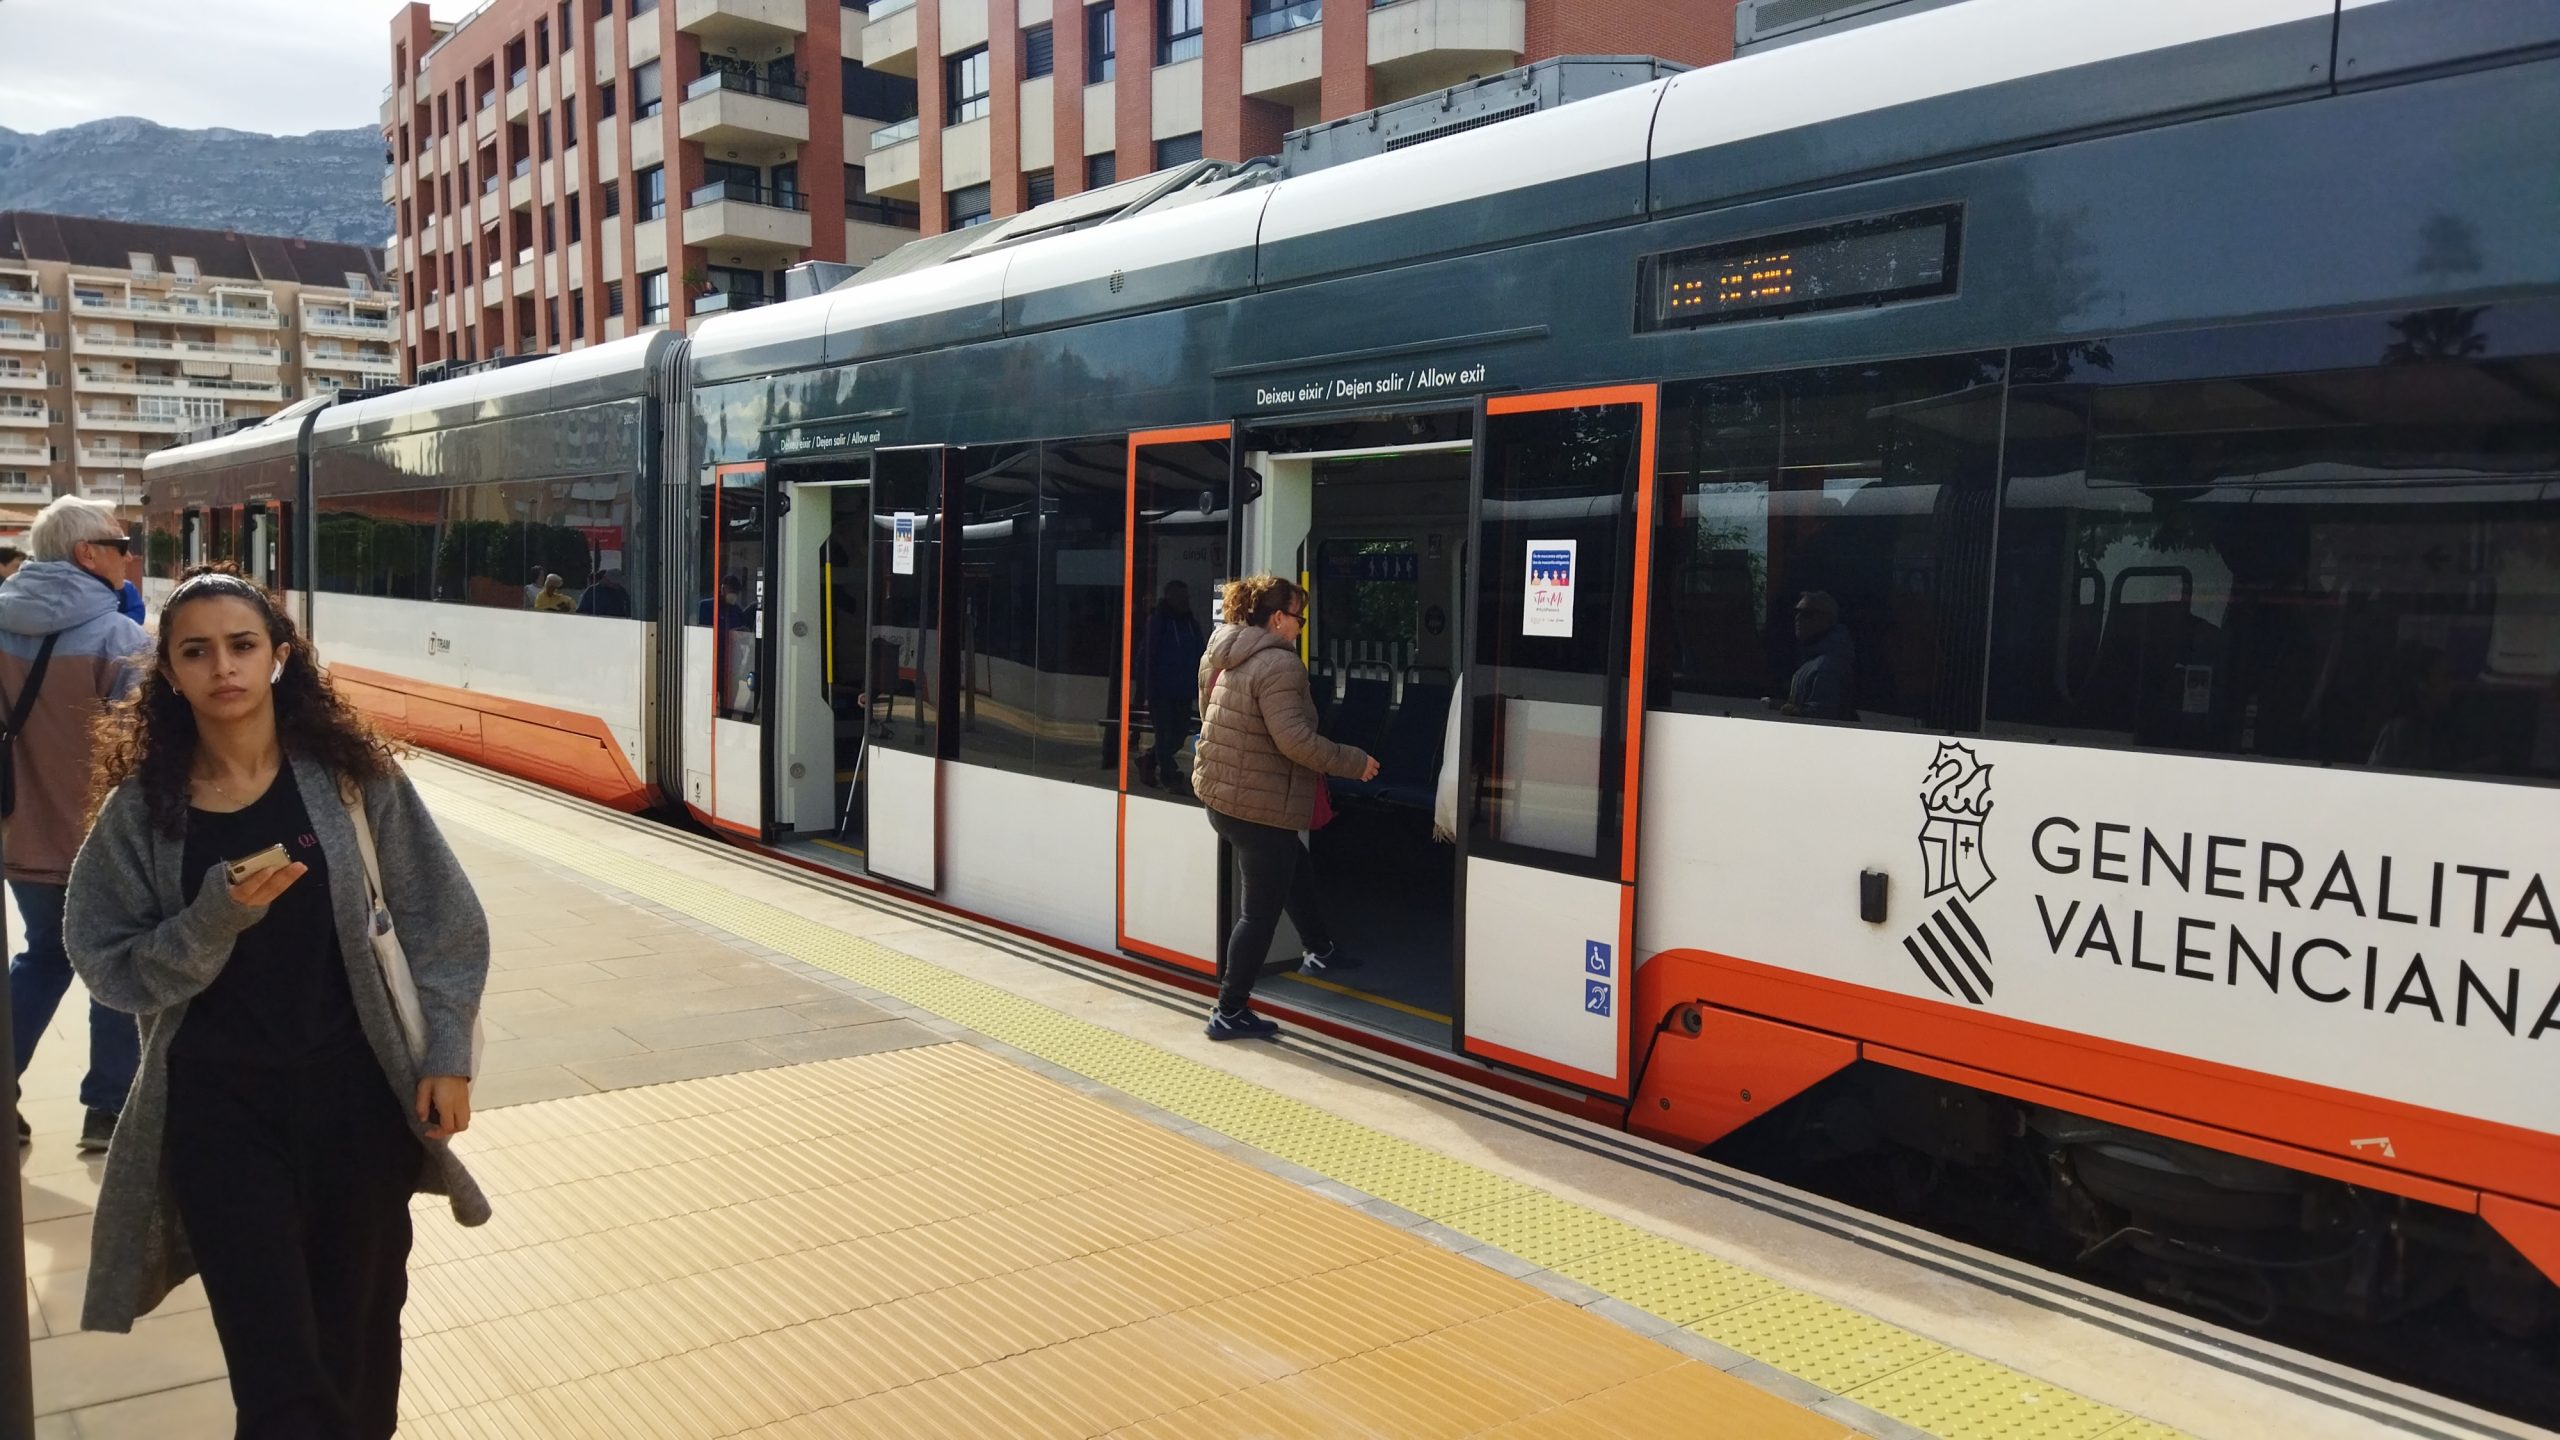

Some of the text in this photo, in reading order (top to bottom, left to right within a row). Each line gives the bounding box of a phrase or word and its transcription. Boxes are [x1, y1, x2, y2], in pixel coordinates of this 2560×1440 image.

[1256, 363, 1486, 406] Deixeu eixir / Dejen salir / Allow exit
[816, 435, 833, 450] Dejen
[833, 433, 846, 446] salir
[851, 431, 868, 444] Allow
[869, 430, 880, 443] exit
[437, 638, 450, 650] TRAM
[2031, 816, 2560, 946] GENERALITA
